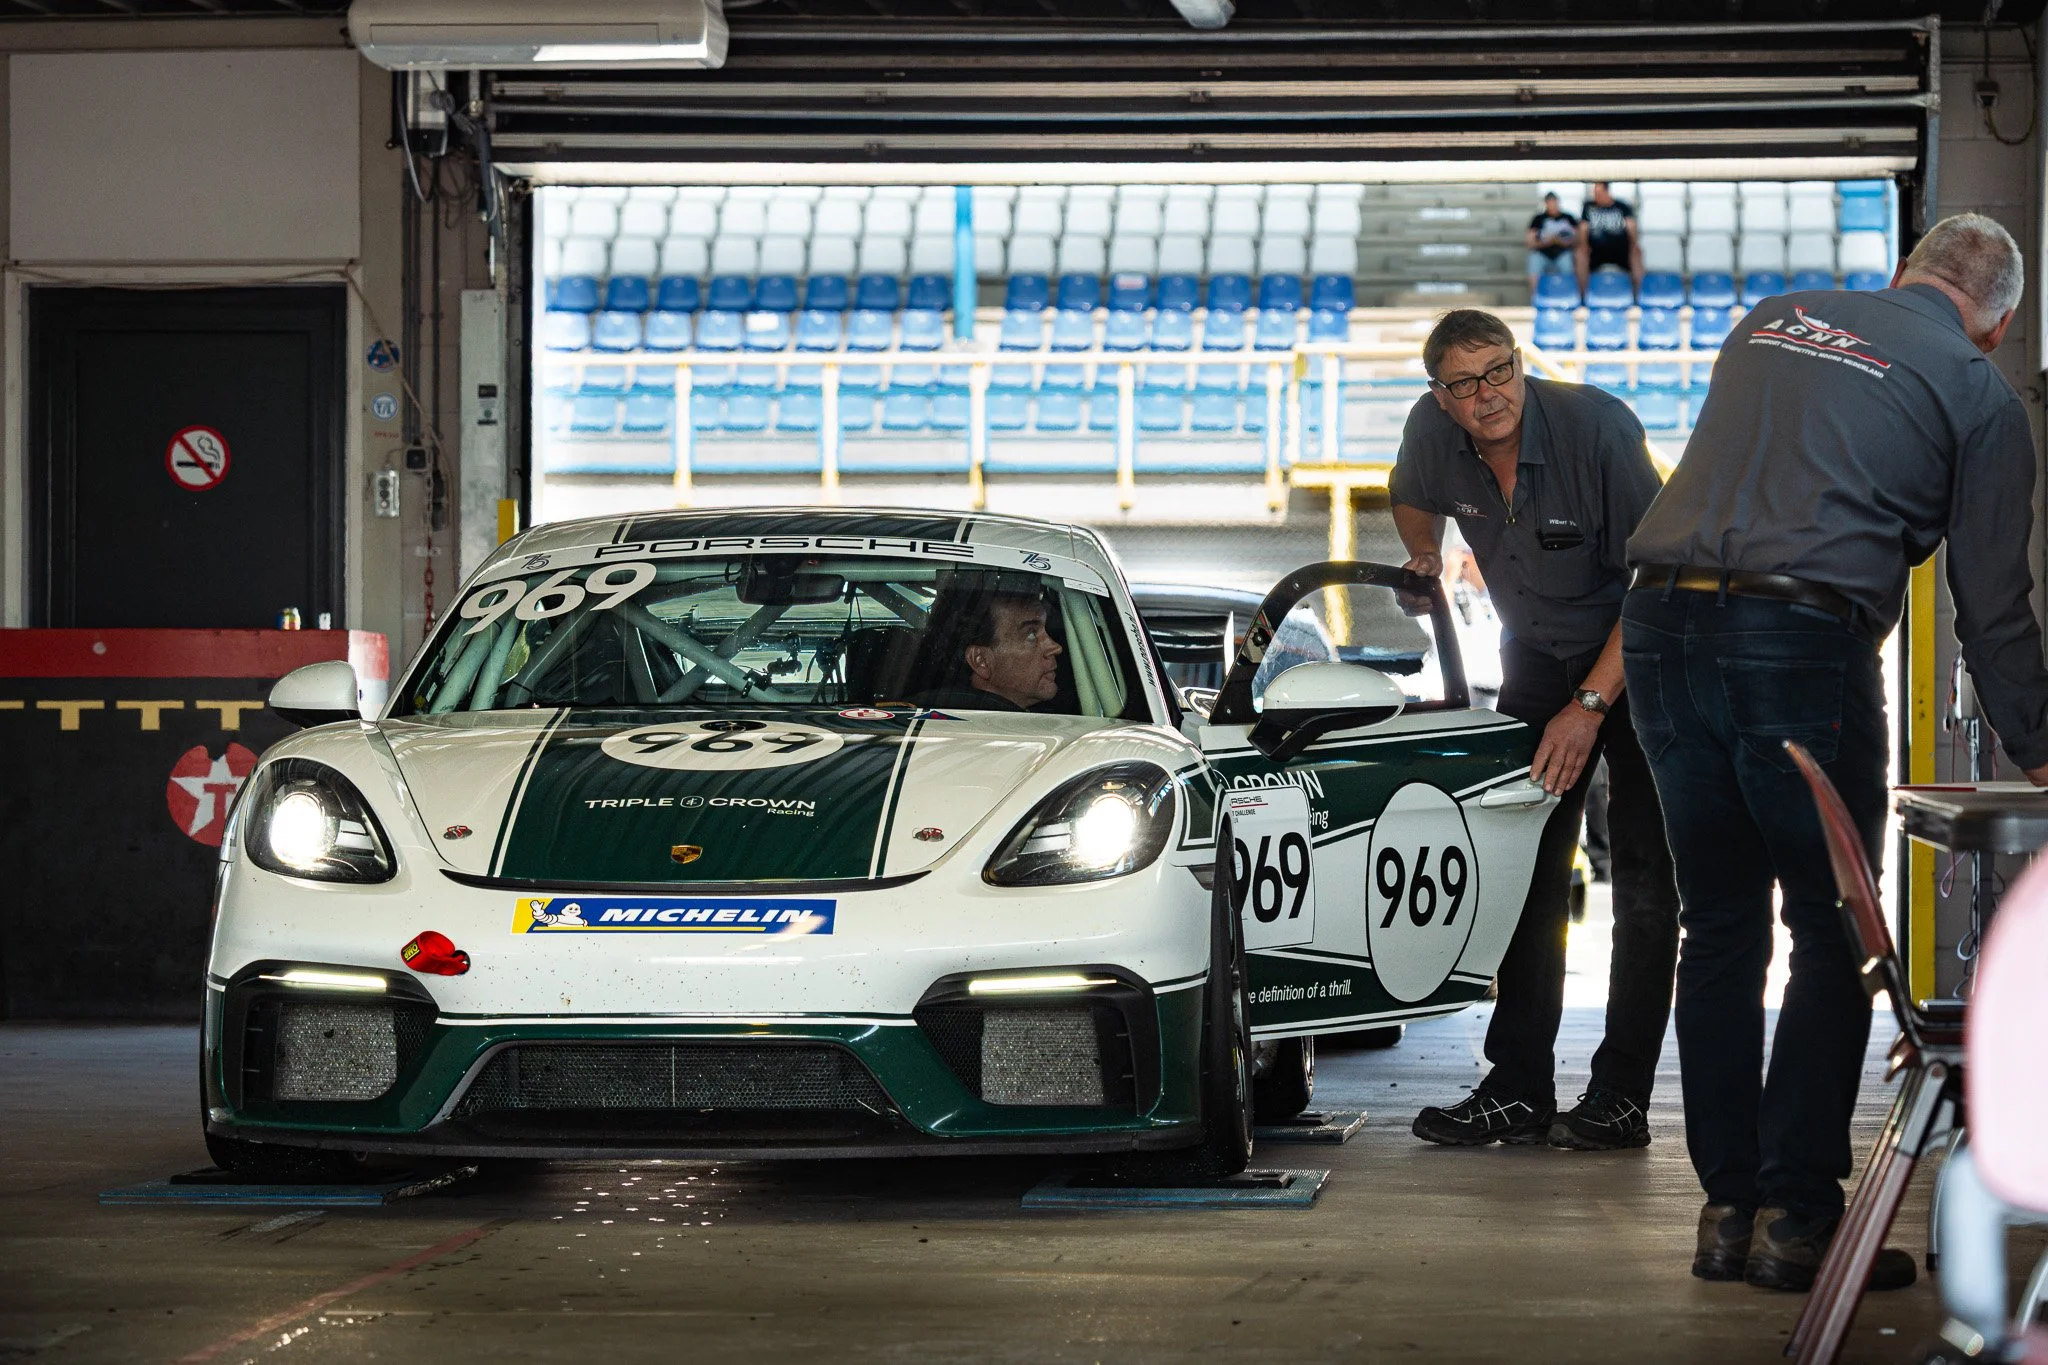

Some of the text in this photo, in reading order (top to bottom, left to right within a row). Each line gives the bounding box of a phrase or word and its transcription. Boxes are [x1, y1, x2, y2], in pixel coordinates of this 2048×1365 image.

[1763, 319, 1857, 348] ACNN
[1748, 338, 1782, 346] AUTOSPORT
[1818, 352, 1842, 362] NOORD
[1843, 358, 1885, 379] NEDERLAND
[594, 537, 974, 559] PORSCHE
[460, 561, 657, 636] 969
[628, 728, 824, 754] 969
[586, 797, 816, 811] TRIPLE CROWN
[766, 808, 815, 817] Racing
[1376, 845, 1468, 929] 969
[599, 908, 814, 923] MICHELIN
[1258, 984, 1305, 1003] definition
[1307, 981, 1319, 999] of
[1320, 985, 1326, 997] a
[1329, 979, 1352, 997] thrill.
